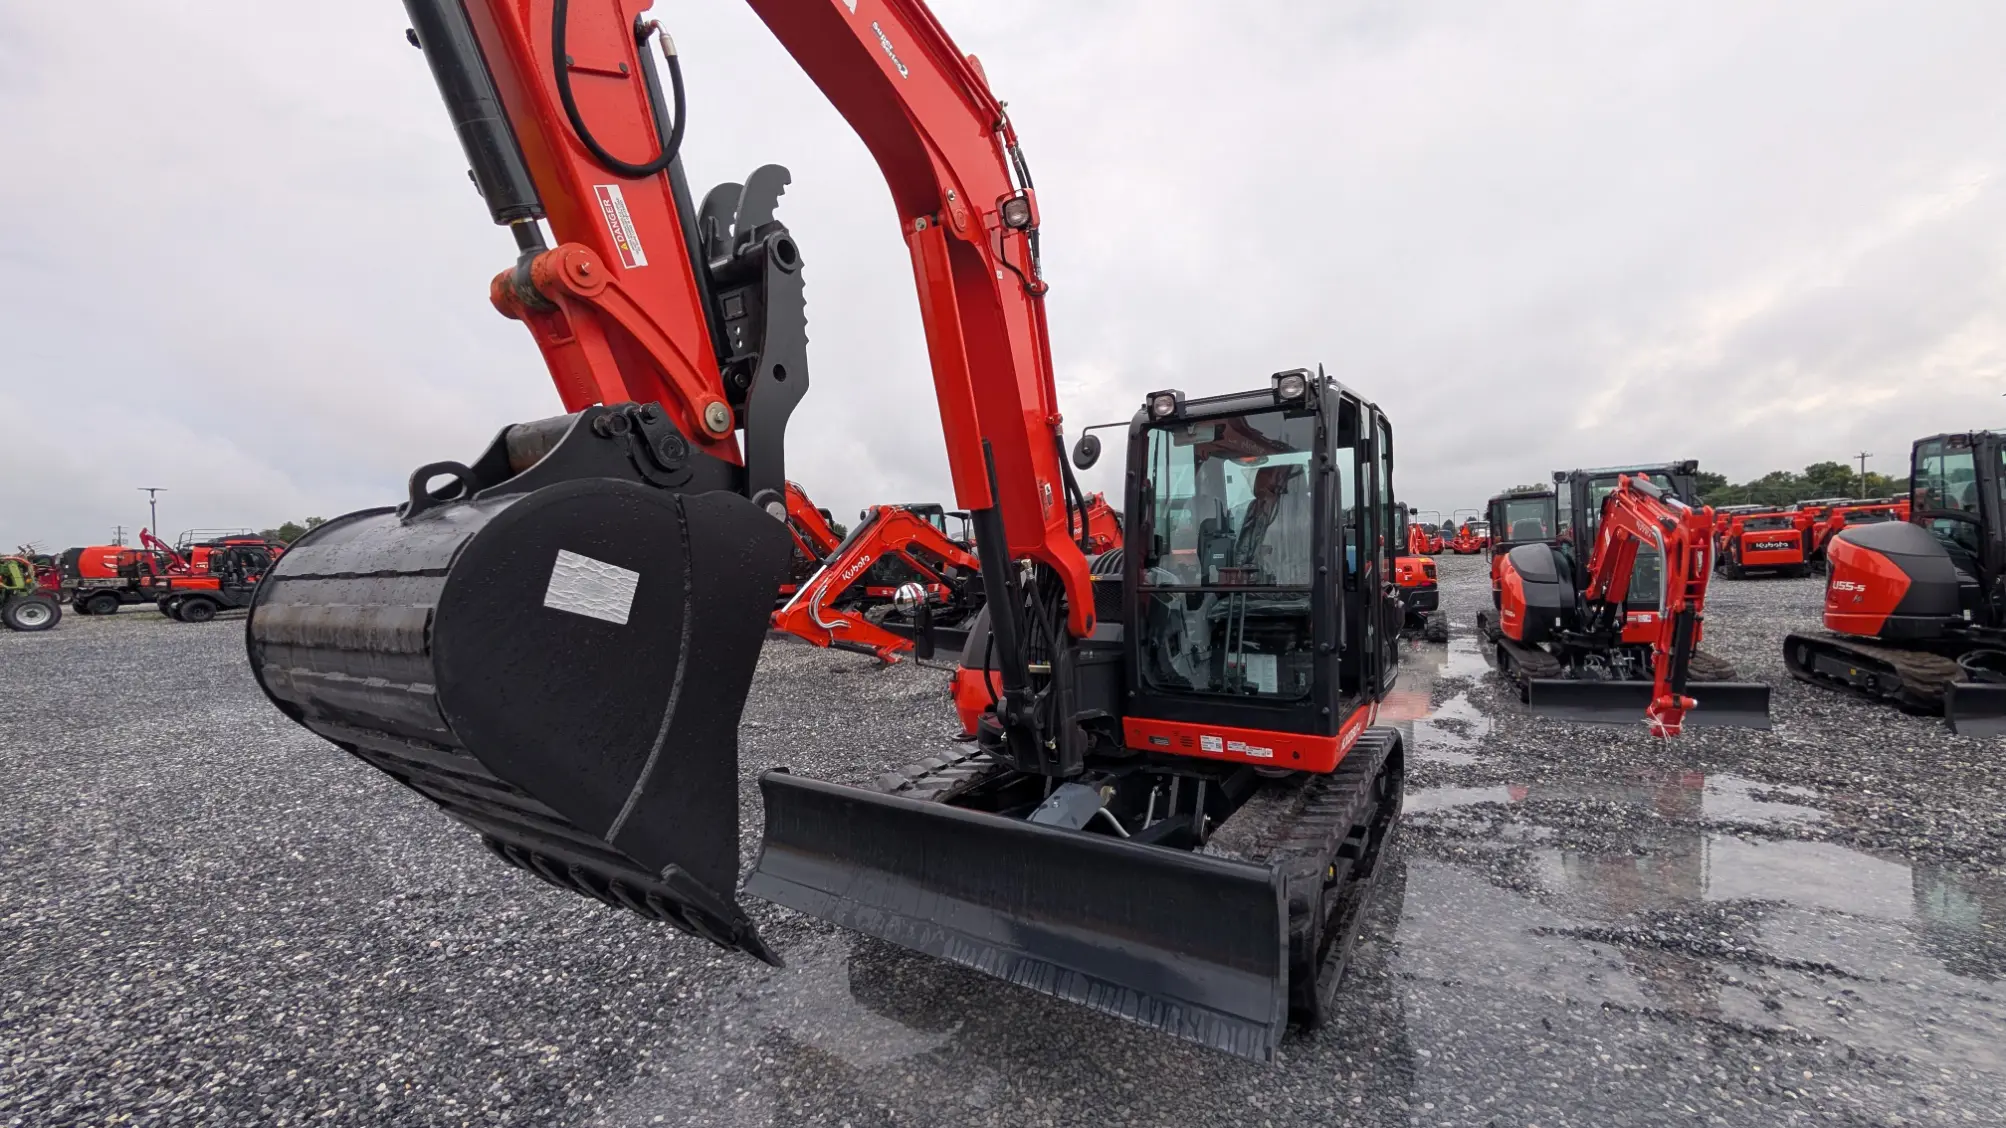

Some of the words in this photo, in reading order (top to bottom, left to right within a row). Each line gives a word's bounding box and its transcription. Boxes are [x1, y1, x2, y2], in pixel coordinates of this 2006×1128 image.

[603, 199, 625, 243] DANGER
[1755, 541, 1789, 549] Kubota
[842, 555, 870, 581] Kubota
